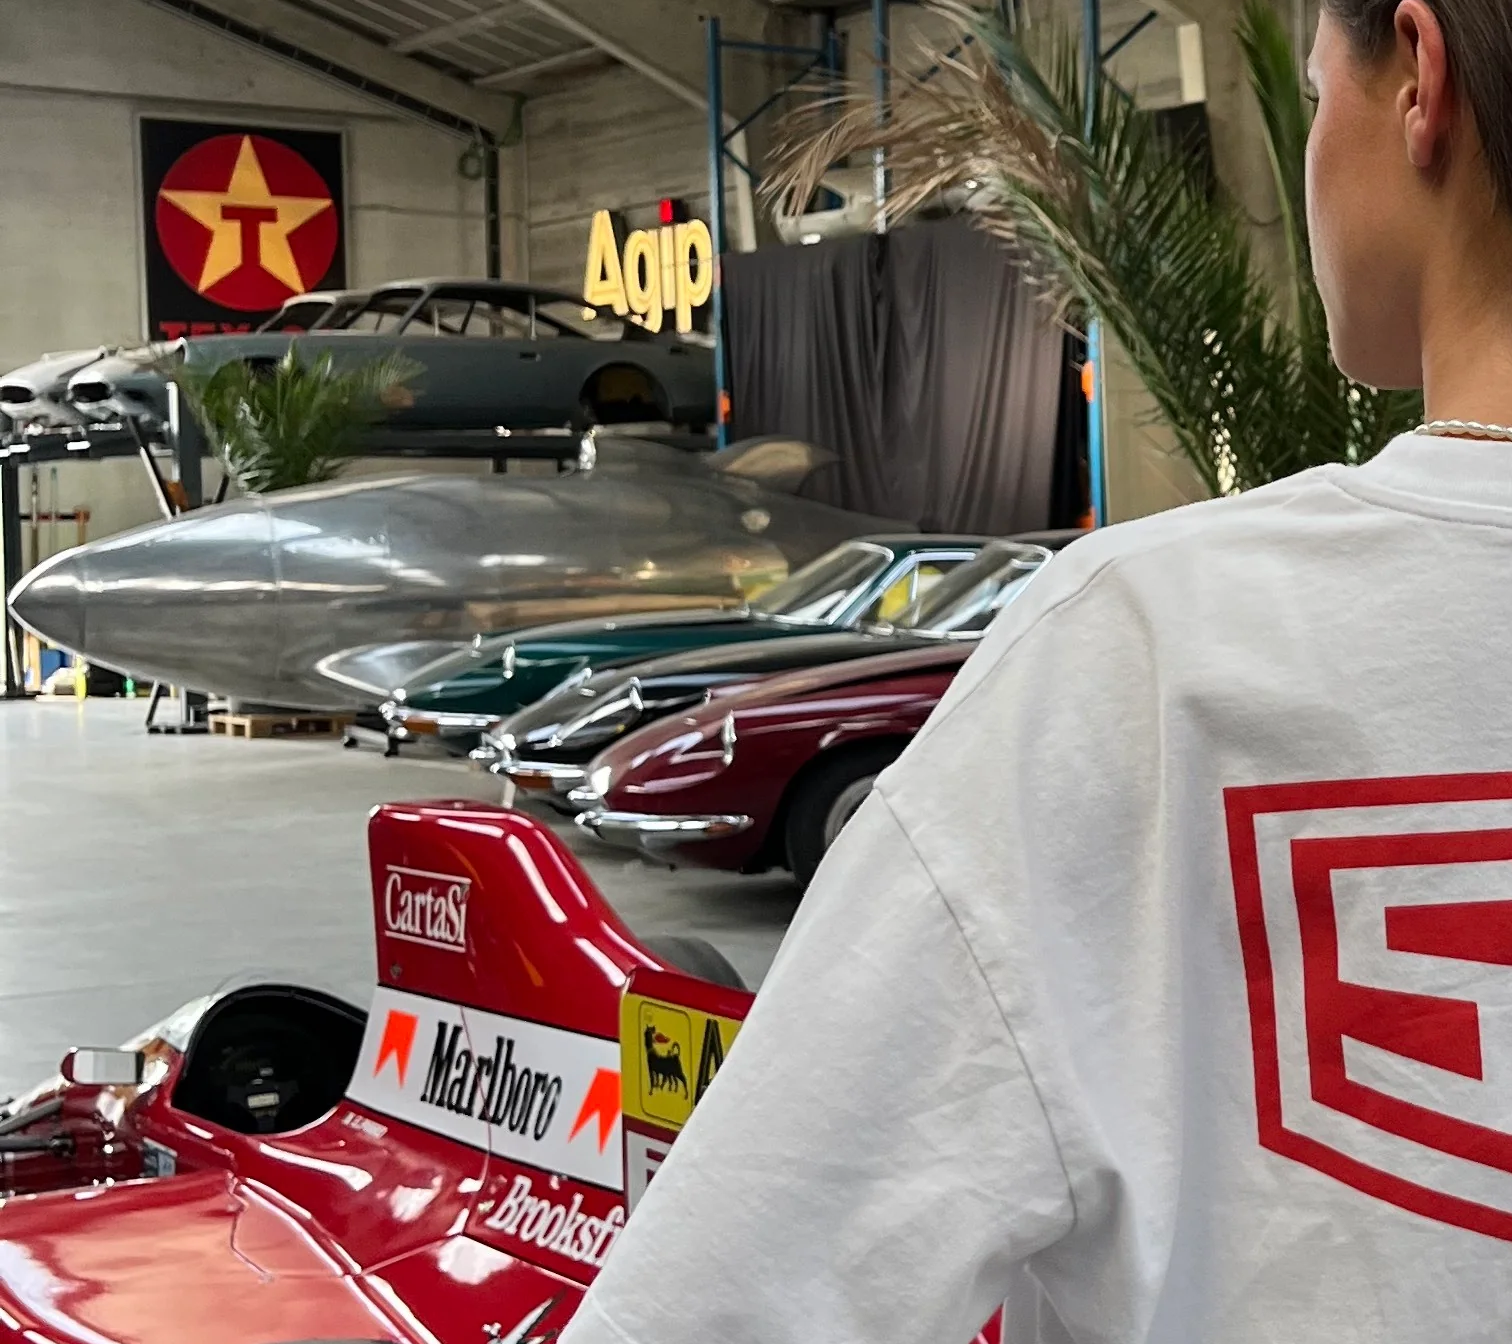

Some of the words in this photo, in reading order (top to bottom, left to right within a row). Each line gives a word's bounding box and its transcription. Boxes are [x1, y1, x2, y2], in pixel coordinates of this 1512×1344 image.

[583, 198, 712, 333] Agip
[385, 872, 469, 945] CartaSi
[420, 1020, 563, 1142] Marlboro
